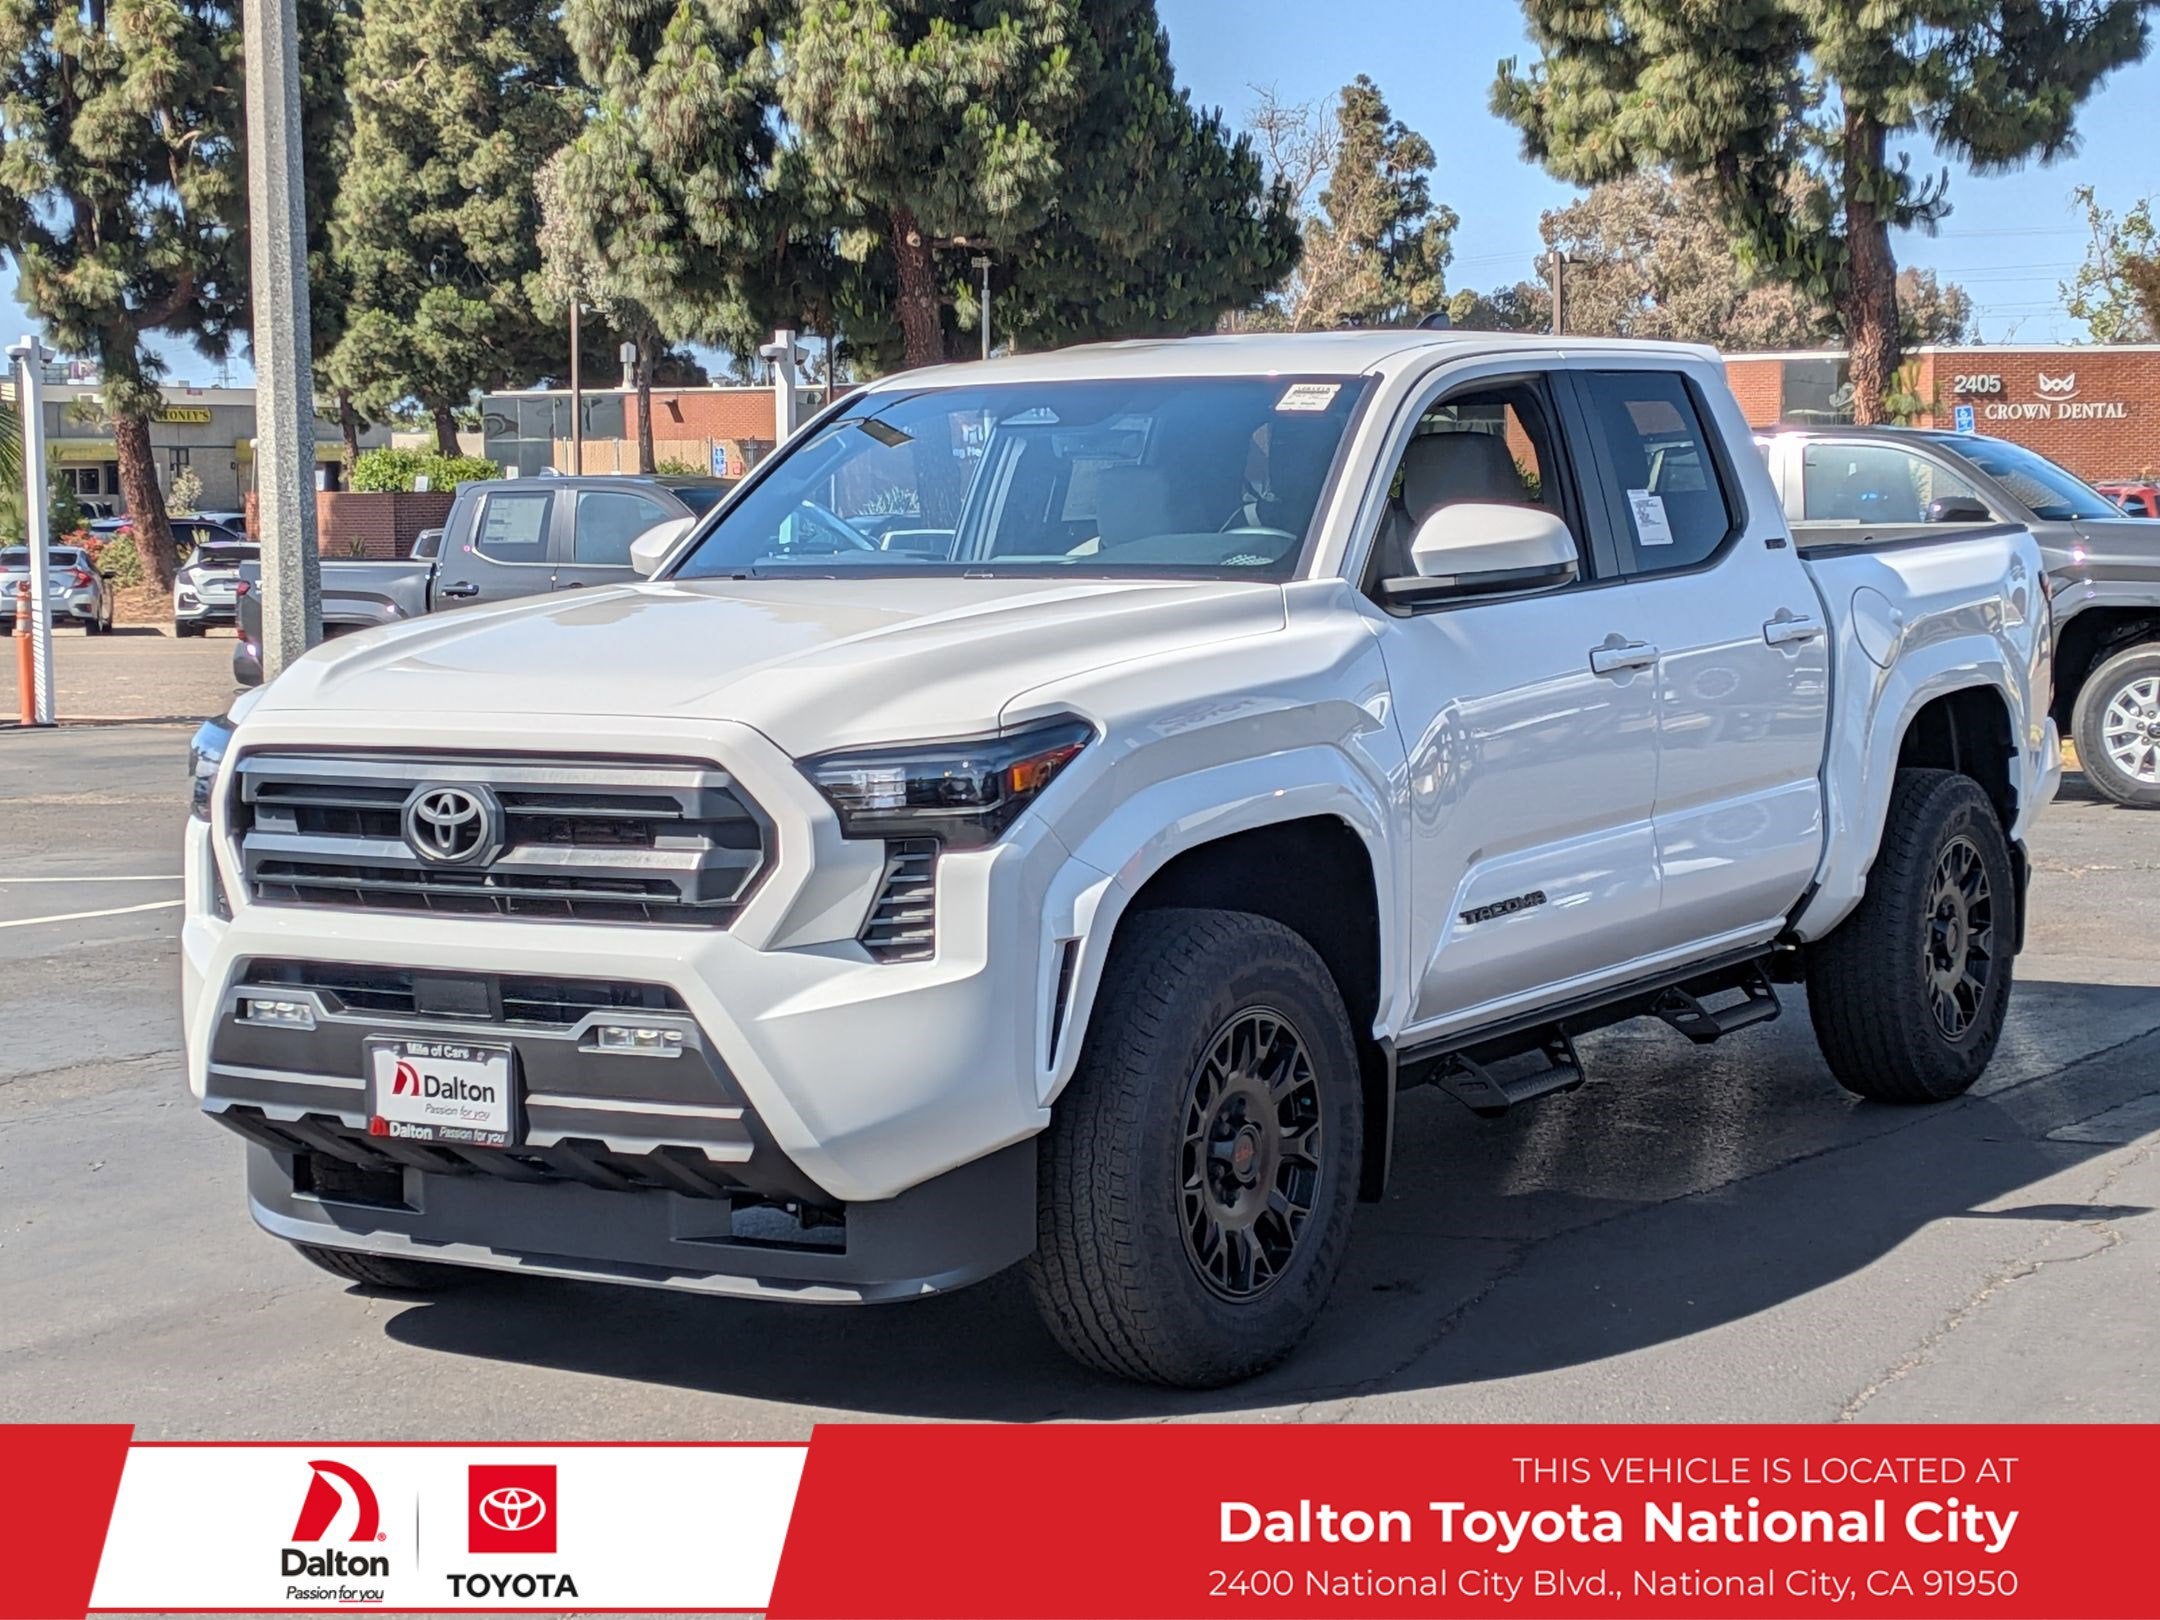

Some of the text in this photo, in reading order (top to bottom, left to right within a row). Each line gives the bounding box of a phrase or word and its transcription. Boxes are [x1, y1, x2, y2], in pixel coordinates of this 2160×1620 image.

[1953, 374, 2001, 393] 2405
[1985, 403, 2051, 420] CROWN
[2058, 403, 2128, 419] DENTAL
[1459, 890, 1547, 925] TACOMA
[406, 1042, 470, 1059] Mile of Cars
[424, 1075, 495, 1103] Dalton
[425, 1103, 491, 1121] Passion for you
[389, 1121, 505, 1144] Dalton Passion for you
